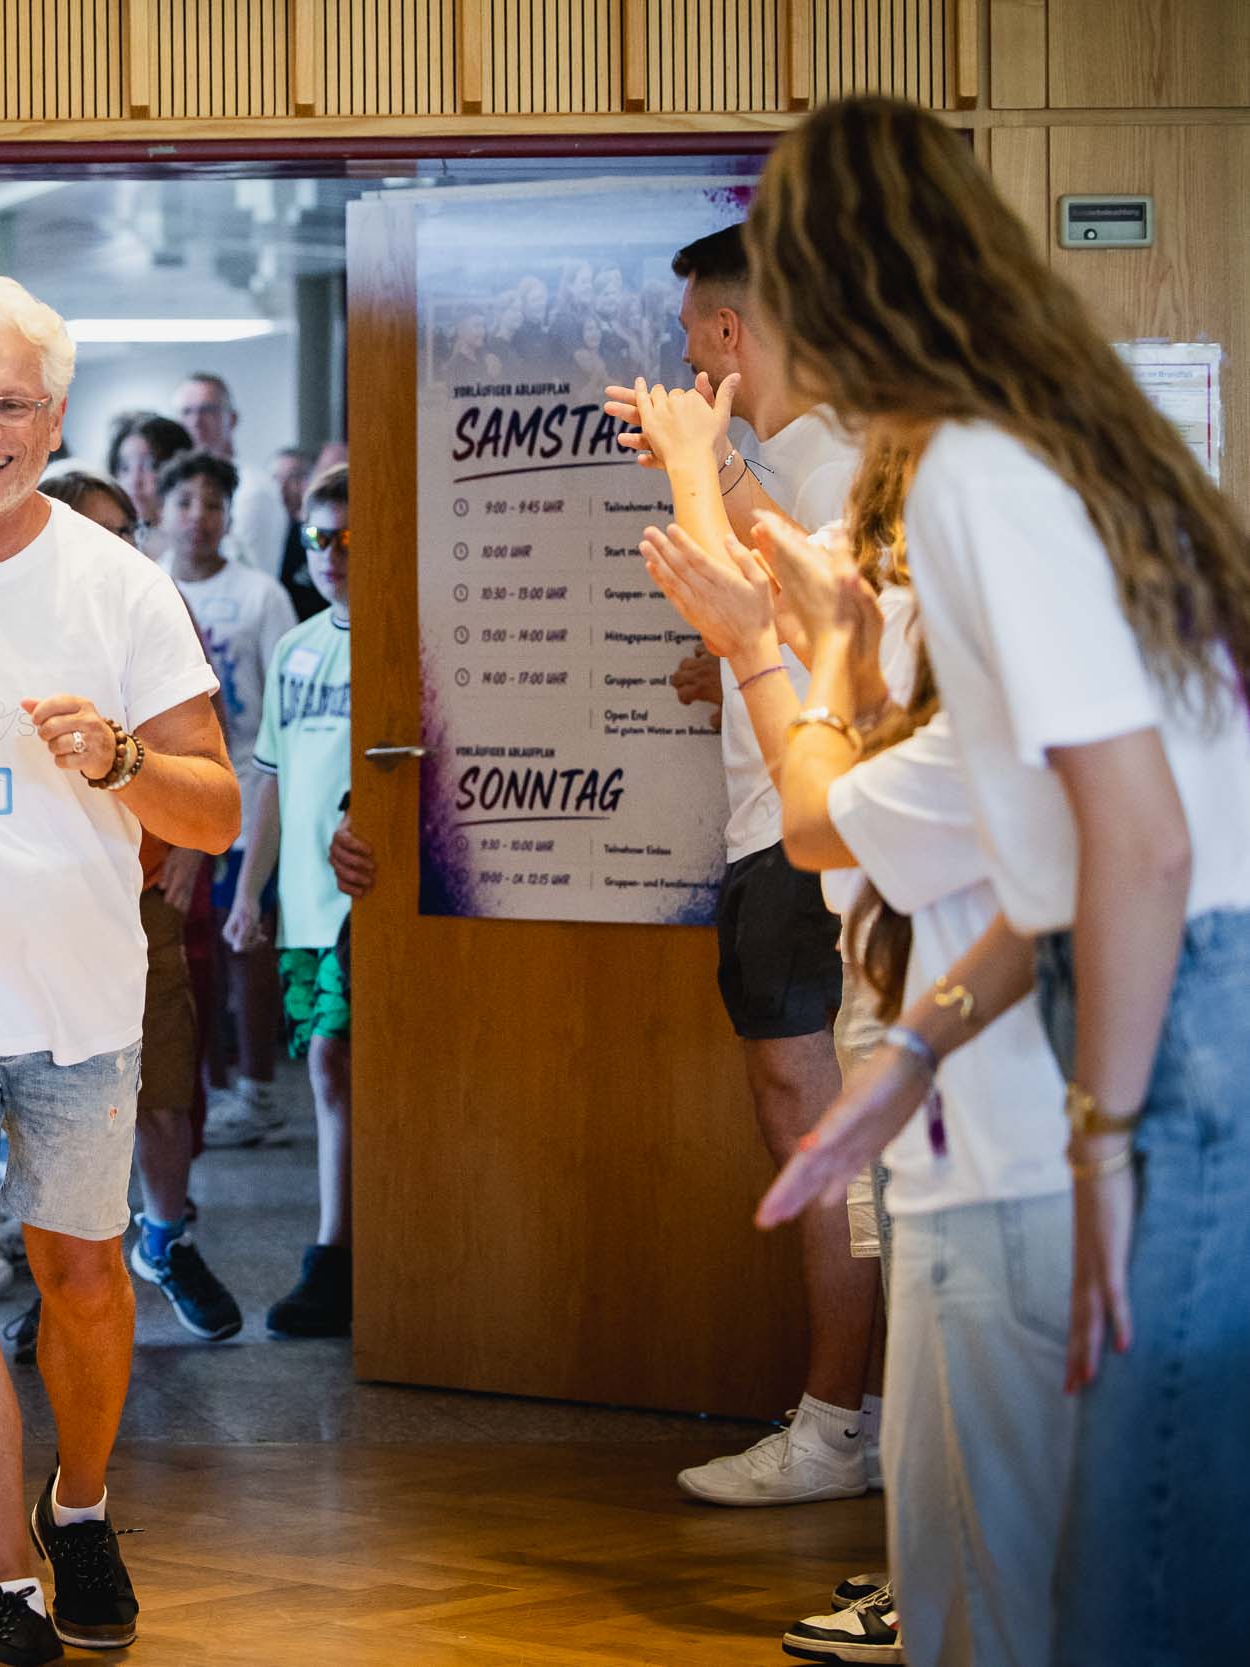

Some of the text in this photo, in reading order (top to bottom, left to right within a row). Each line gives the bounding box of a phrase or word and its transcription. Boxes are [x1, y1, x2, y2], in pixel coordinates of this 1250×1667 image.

[453, 383, 512, 399] VORLÄUFIGER
[542, 499, 565, 514] UHR
[604, 500, 674, 514] Teilnehmer-Reg
[481, 544, 533, 559] 10:00 UHR
[604, 546, 626, 558] Start
[481, 587, 507, 600] 10:30
[545, 586, 568, 600] UHR
[604, 587, 646, 602] Gruppen-
[518, 629, 544, 643] 14:00
[545, 628, 568, 643] UHR
[604, 629, 663, 645] Mittagspause
[481, 672, 507, 685] 14:00
[518, 671, 544, 685] 17:00
[546, 671, 568, 685] UHR
[604, 674, 646, 688] Gruppen-
[649, 674, 667, 686] und
[604, 709, 648, 723] Open End
[456, 744, 556, 759] VORLÄUFIGER ABLAUFPLAN
[455, 765, 625, 812] SONNTAG
[535, 840, 555, 852] UHR
[550, 874, 571, 886] UHR
[604, 876, 641, 889] Gruppen-
